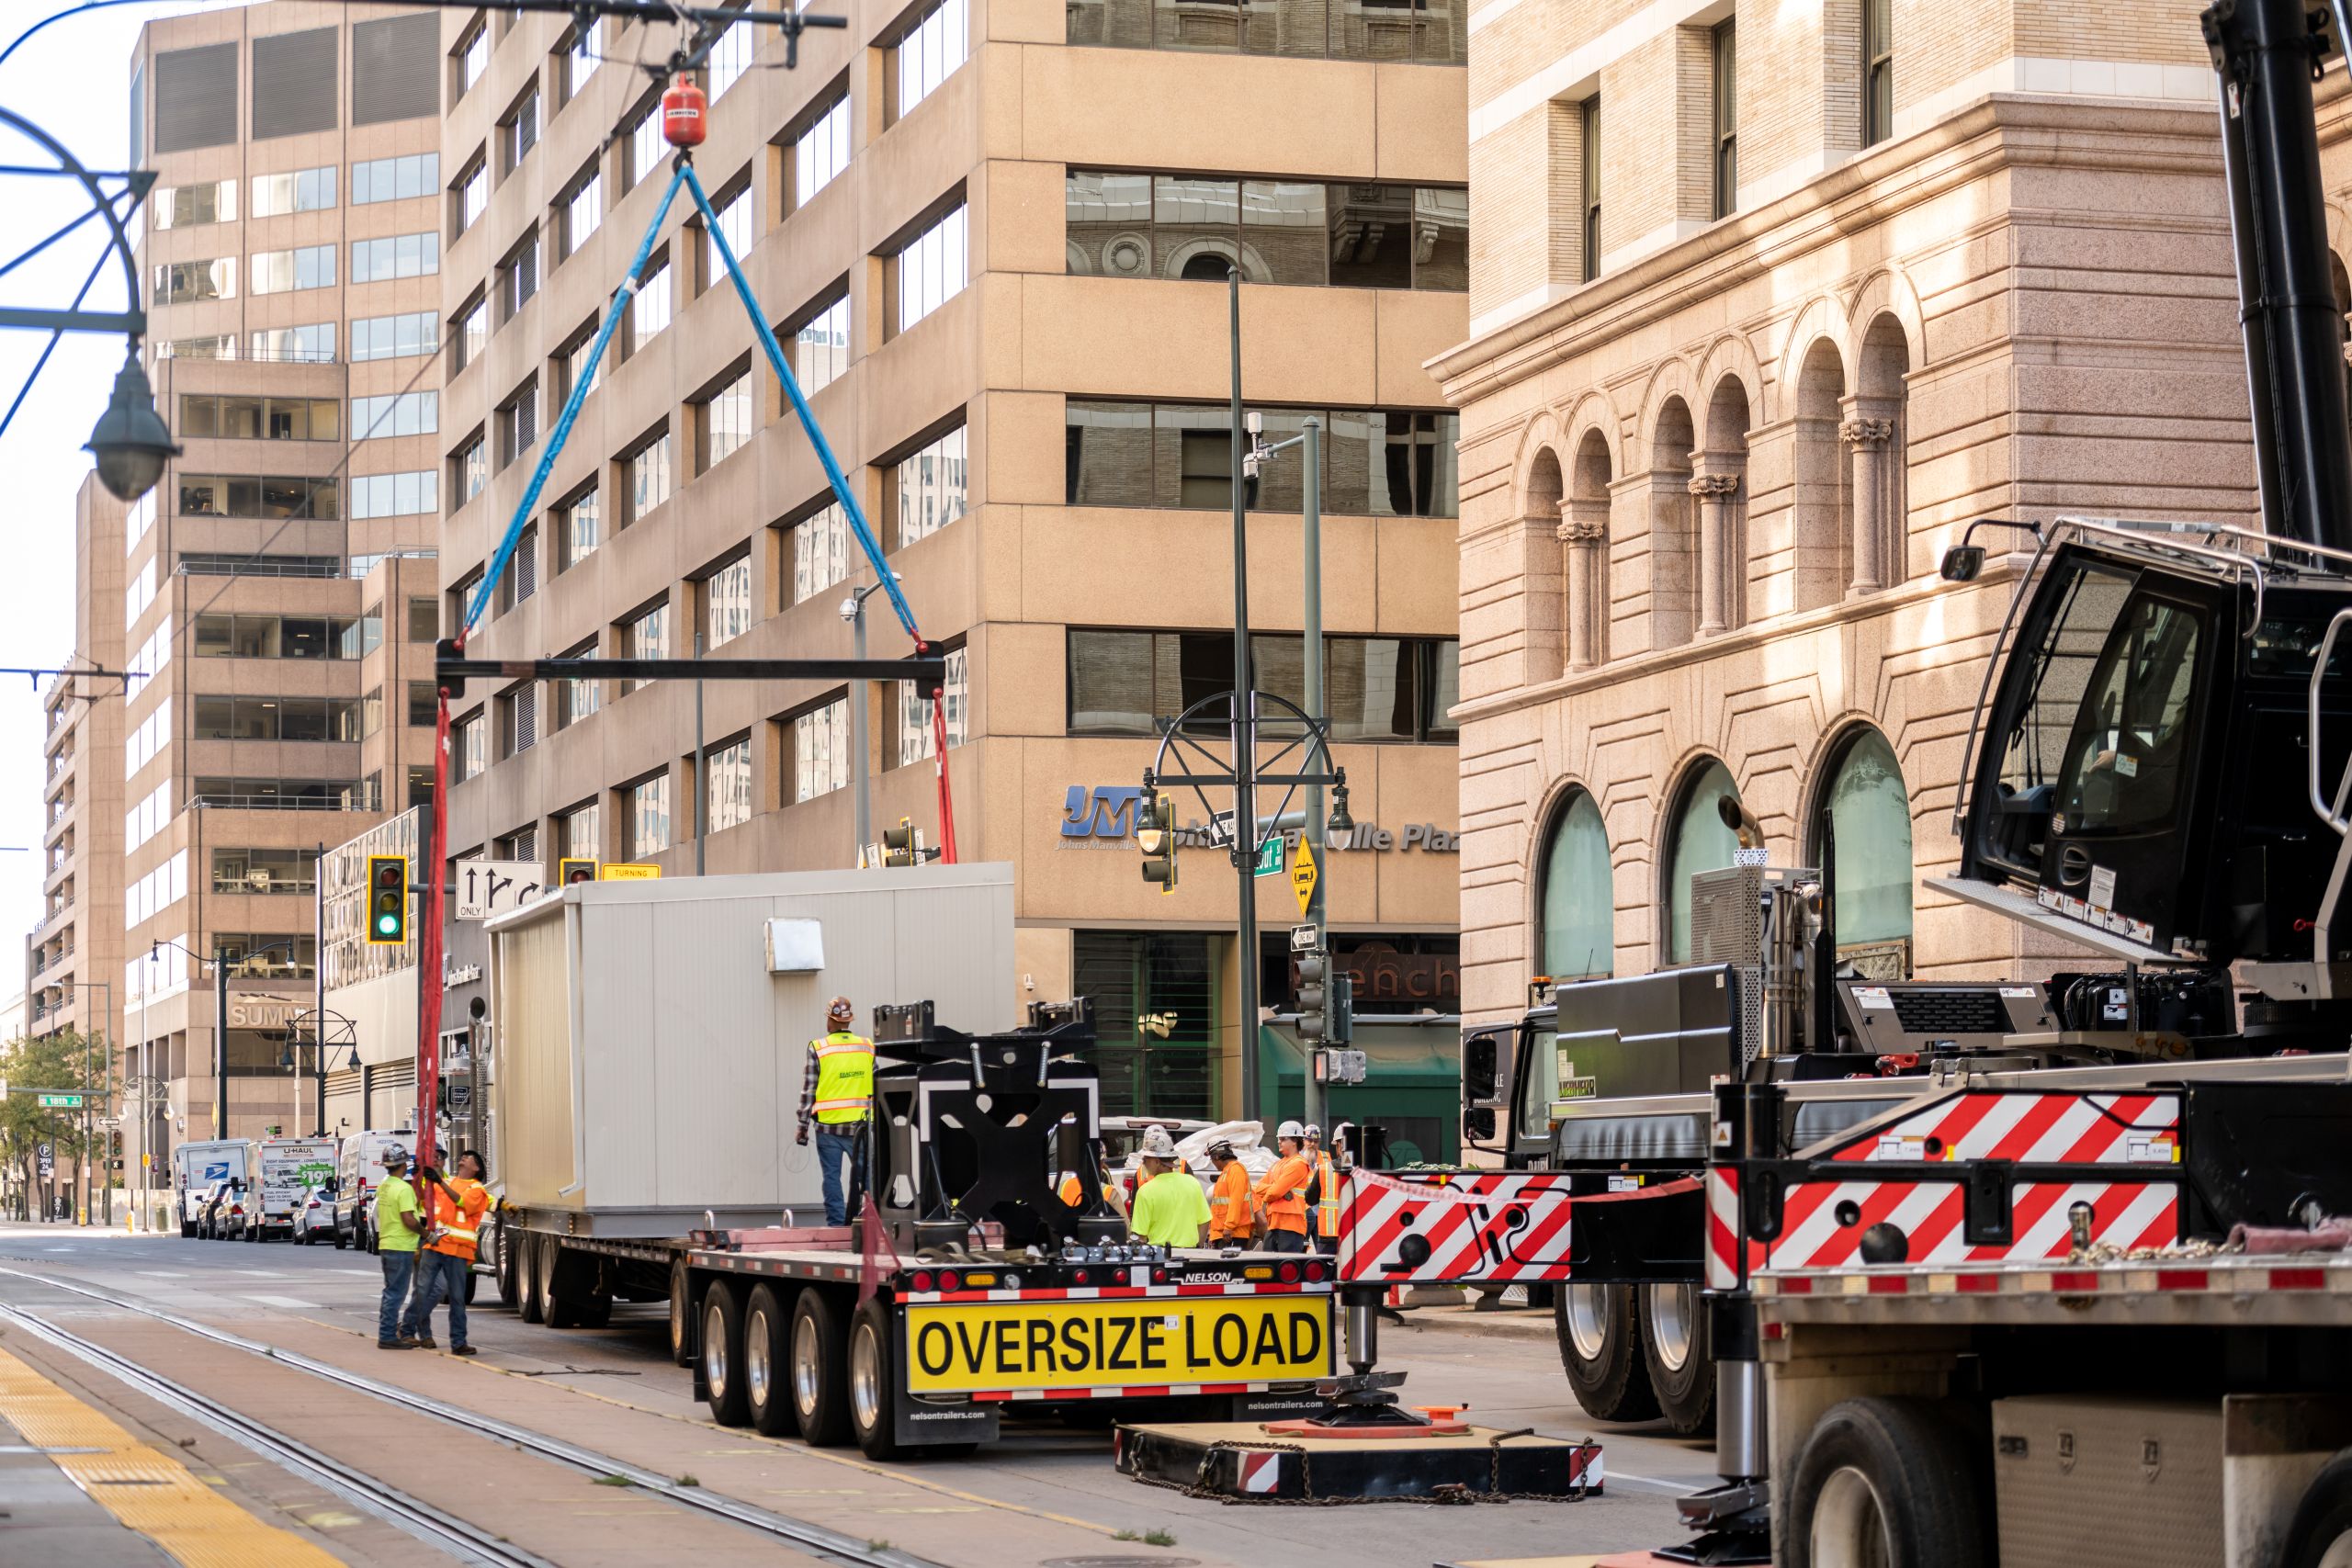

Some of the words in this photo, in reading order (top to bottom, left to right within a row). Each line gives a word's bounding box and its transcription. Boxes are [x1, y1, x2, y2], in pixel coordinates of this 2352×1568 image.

[1061, 785, 1141, 837] JM
[1400, 824, 1460, 852] Plaz
[1055, 840, 1088, 851] Johns
[1091, 840, 1136, 851] Manville
[615, 869, 648, 877] TURNING
[460, 907, 481, 917] ONLY
[1347, 959, 1459, 998] ench
[1185, 1272, 1232, 1282] NELSON
[918, 1316, 1167, 1376] OVERSIZE
[1186, 1312, 1321, 1368] LOAD
[1248, 1400, 1323, 1411] nelsontrailers.com
[910, 1411, 985, 1421] nelsontrailers.com
